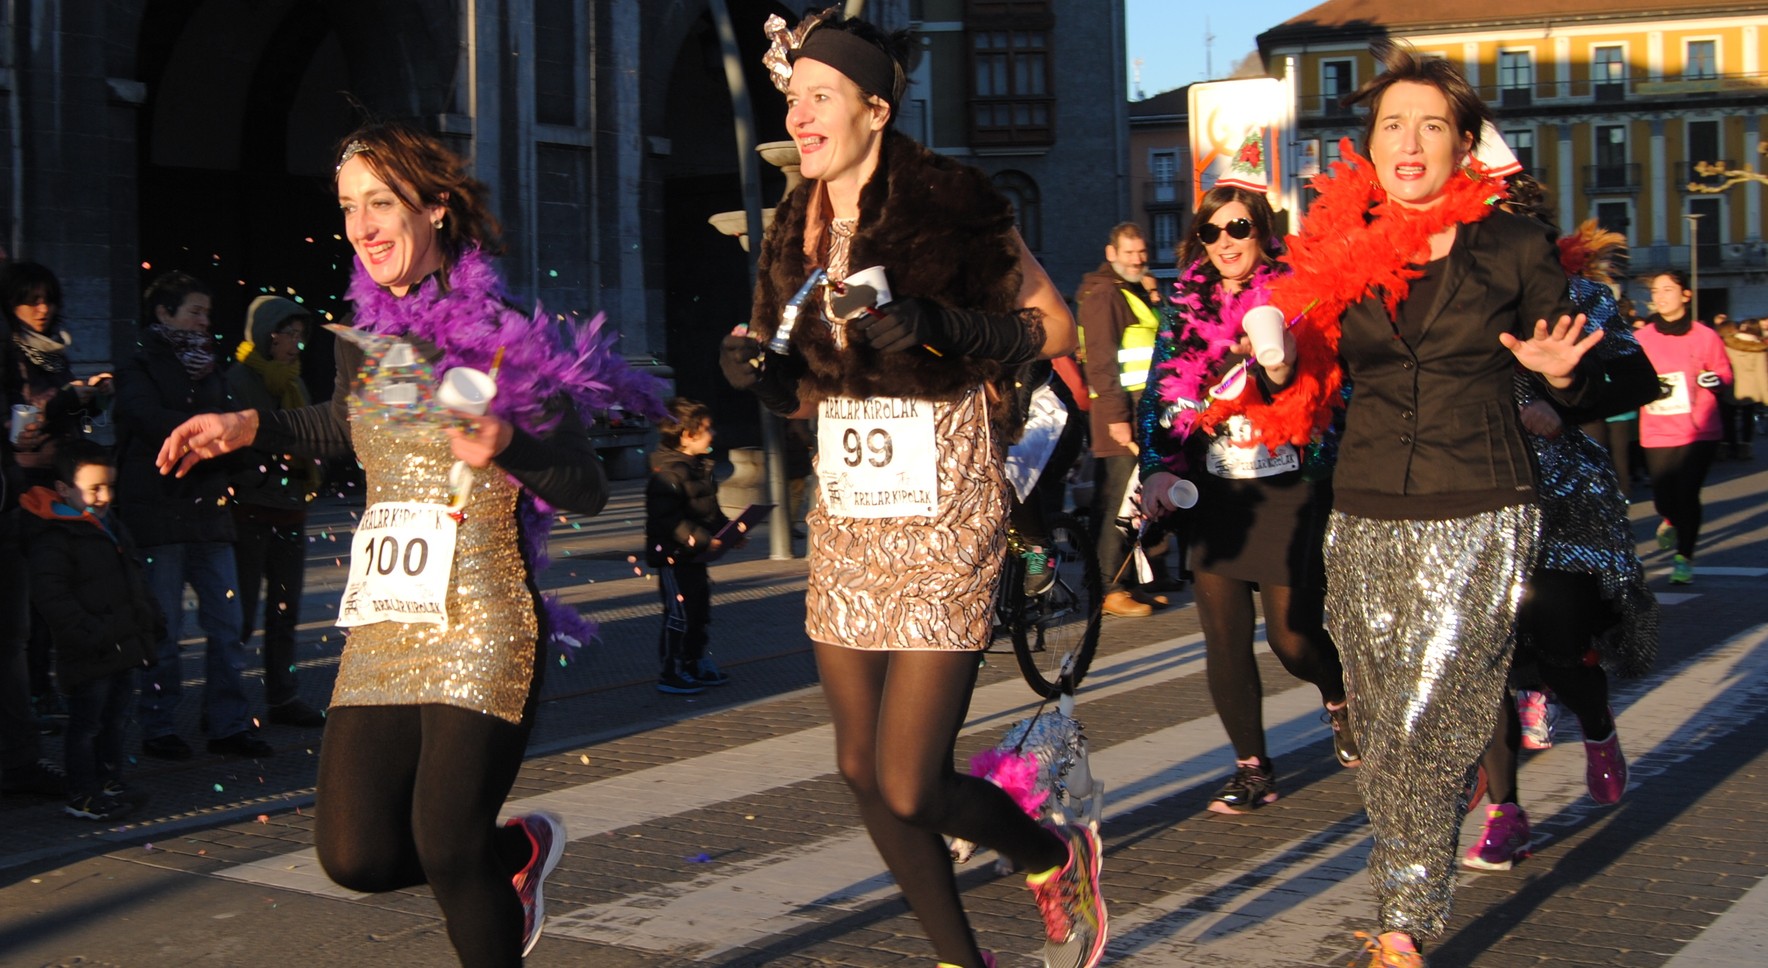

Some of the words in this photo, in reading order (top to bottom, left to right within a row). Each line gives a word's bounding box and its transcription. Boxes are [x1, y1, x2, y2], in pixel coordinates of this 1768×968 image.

[825, 399, 860, 419] ARALAR
[842, 427, 893, 468] 99
[854, 491, 890, 506] ARALAR
[365, 535, 429, 577] 100
